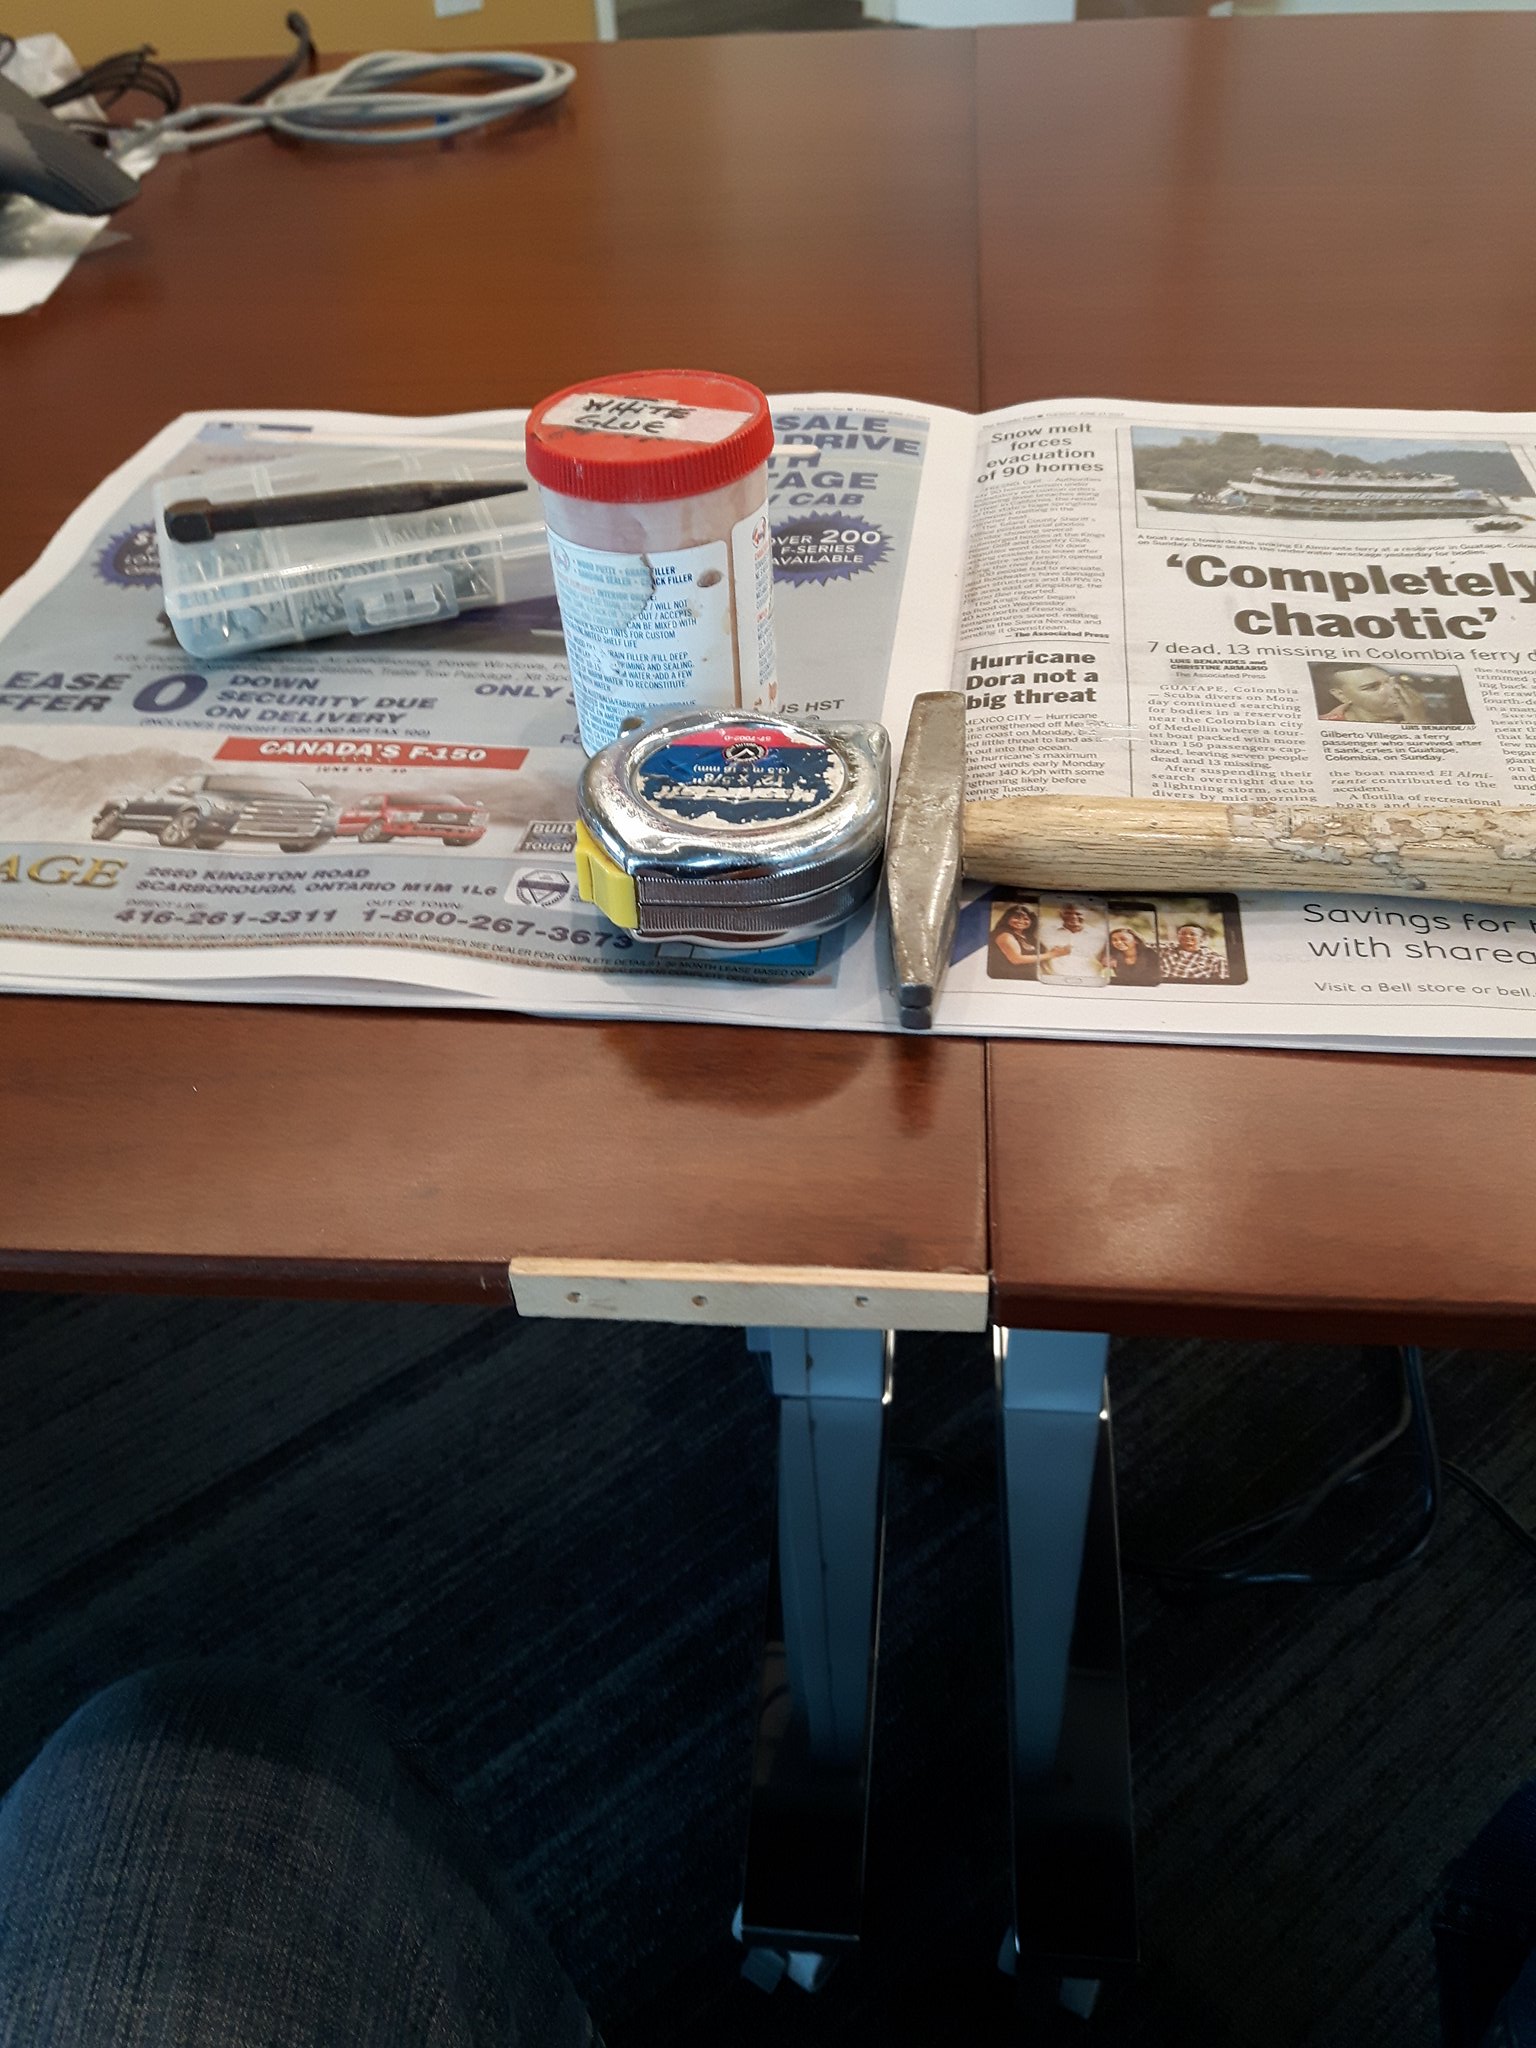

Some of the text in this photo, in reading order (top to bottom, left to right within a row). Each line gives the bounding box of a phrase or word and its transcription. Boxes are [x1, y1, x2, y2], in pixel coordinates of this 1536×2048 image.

[574, 414, 665, 433] GLUE
[774, 414, 889, 433] SALE
[990, 423, 1092, 443] Snow melt
[783, 434, 921, 456] DRIVE
[1010, 437, 1072, 451] forces
[986, 448, 1095, 468] evacuation
[977, 461, 1104, 484] of 90 homes
[789, 493, 864, 506] CAB
[820, 530, 881, 544] 200
[781, 544, 855, 554] F-SERIES
[668, 574, 693, 584] FILLER
[630, 630, 644, 638] FOR
[646, 631, 676, 640] CUSTOM
[670, 652, 689, 661] DEEP
[1147, 641, 1159, 653] 7
[1226, 643, 1250, 655] 13
[1257, 645, 1337, 660] missing
[1342, 647, 1360, 658] in
[1366, 648, 1465, 660] Colombia
[1470, 649, 1520, 664] ferry
[970, 650, 1096, 671] Hurricane
[966, 669, 1098, 691] Dora not a
[1476, 674, 1528, 682] trimmed
[133, 673, 208, 714] 0
[229, 674, 320, 690] DOWN
[1164, 691, 1202, 699] Scuba
[1205, 692, 1242, 700] divers
[1233, 686, 1299, 695] Colombia
[205, 684, 564, 724] ON DELIVERY ONLY
[216, 689, 369, 708] SECURITY
[374, 697, 438, 709] DUE
[805, 699, 845, 712] HST
[966, 688, 1097, 710] big threat
[1147, 699, 1301, 712] day continued searching
[1148, 715, 1304, 730] near the Colombian city
[1166, 731, 1193, 740] boat
[1197, 733, 1240, 743] packed
[1243, 735, 1271, 744] with
[258, 741, 401, 759] CANADA'S
[409, 745, 487, 762] F-150
[1150, 739, 1177, 747] than
[1183, 740, 1203, 748] 150
[1206, 742, 1275, 753] passengers
[1150, 755, 1179, 763] dead
[1182, 757, 1204, 765] and
[1186, 749, 1228, 759] leaving
[1268, 754, 1309, 763] people
[999, 759, 1105, 768] winds early Monday
[1164, 764, 1312, 778] After suspending their
[1021, 776, 1087, 785] likely before
[1151, 773, 1195, 782] search
[1199, 775, 1264, 786] overnight
[1152, 790, 1318, 803] divers by mid-morning
[203, 870, 307, 881] KINGSTON
[312, 868, 370, 879] ROAD
[305, 881, 395, 893] ONTARIO
[403, 882, 453, 894] M1M
[461, 884, 498, 896] 1L6
[1303, 903, 1517, 935] Savings for
[114, 909, 338, 925] 416-261-3311
[362, 909, 635, 950] 1-800-267-3673
[1308, 936, 1391, 959] with
[1314, 981, 1355, 992] Visit
[1361, 984, 1372, 992] a
[1378, 983, 1411, 993] Bell
[1419, 983, 1466, 994] store
[1472, 986, 1491, 994] or
